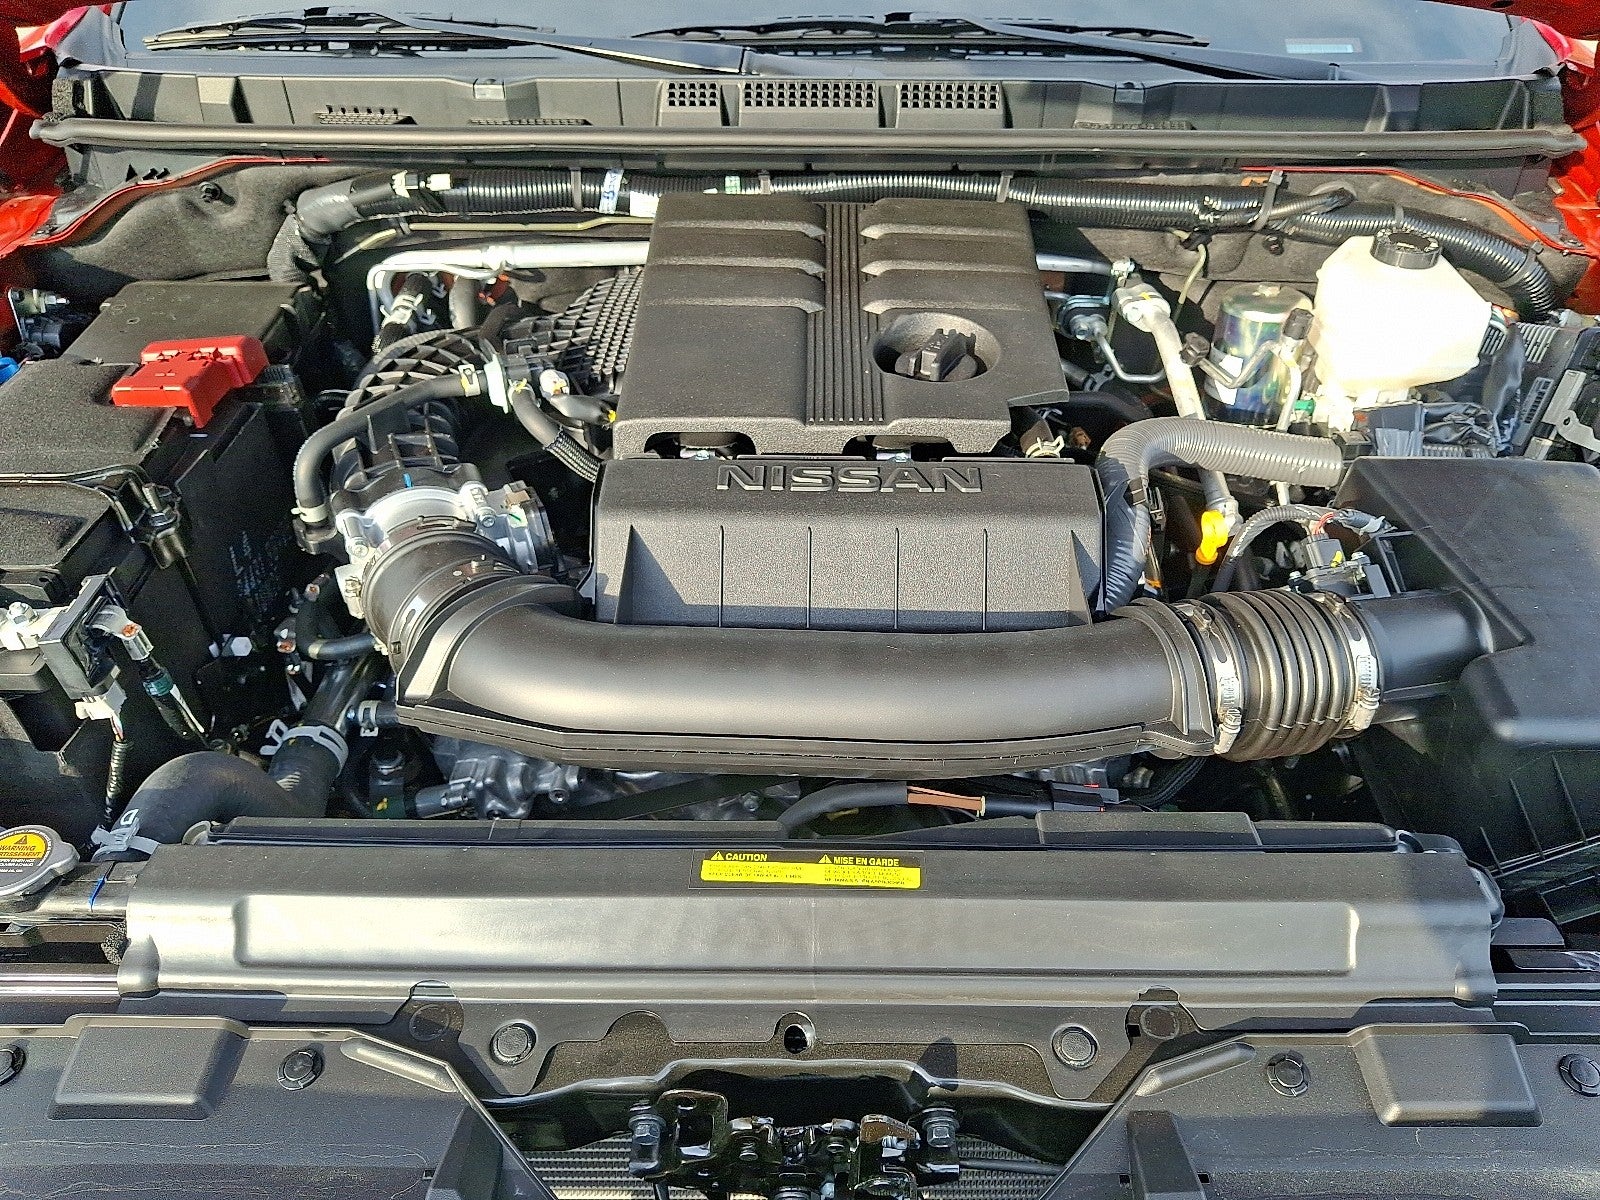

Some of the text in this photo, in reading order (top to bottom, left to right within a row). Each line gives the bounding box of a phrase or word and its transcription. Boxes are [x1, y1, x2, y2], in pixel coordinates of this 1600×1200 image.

[716, 465, 983, 493] NISSAN
[725, 852, 768, 862] CAUTION
[833, 856, 900, 867] MISE EN GARDE
